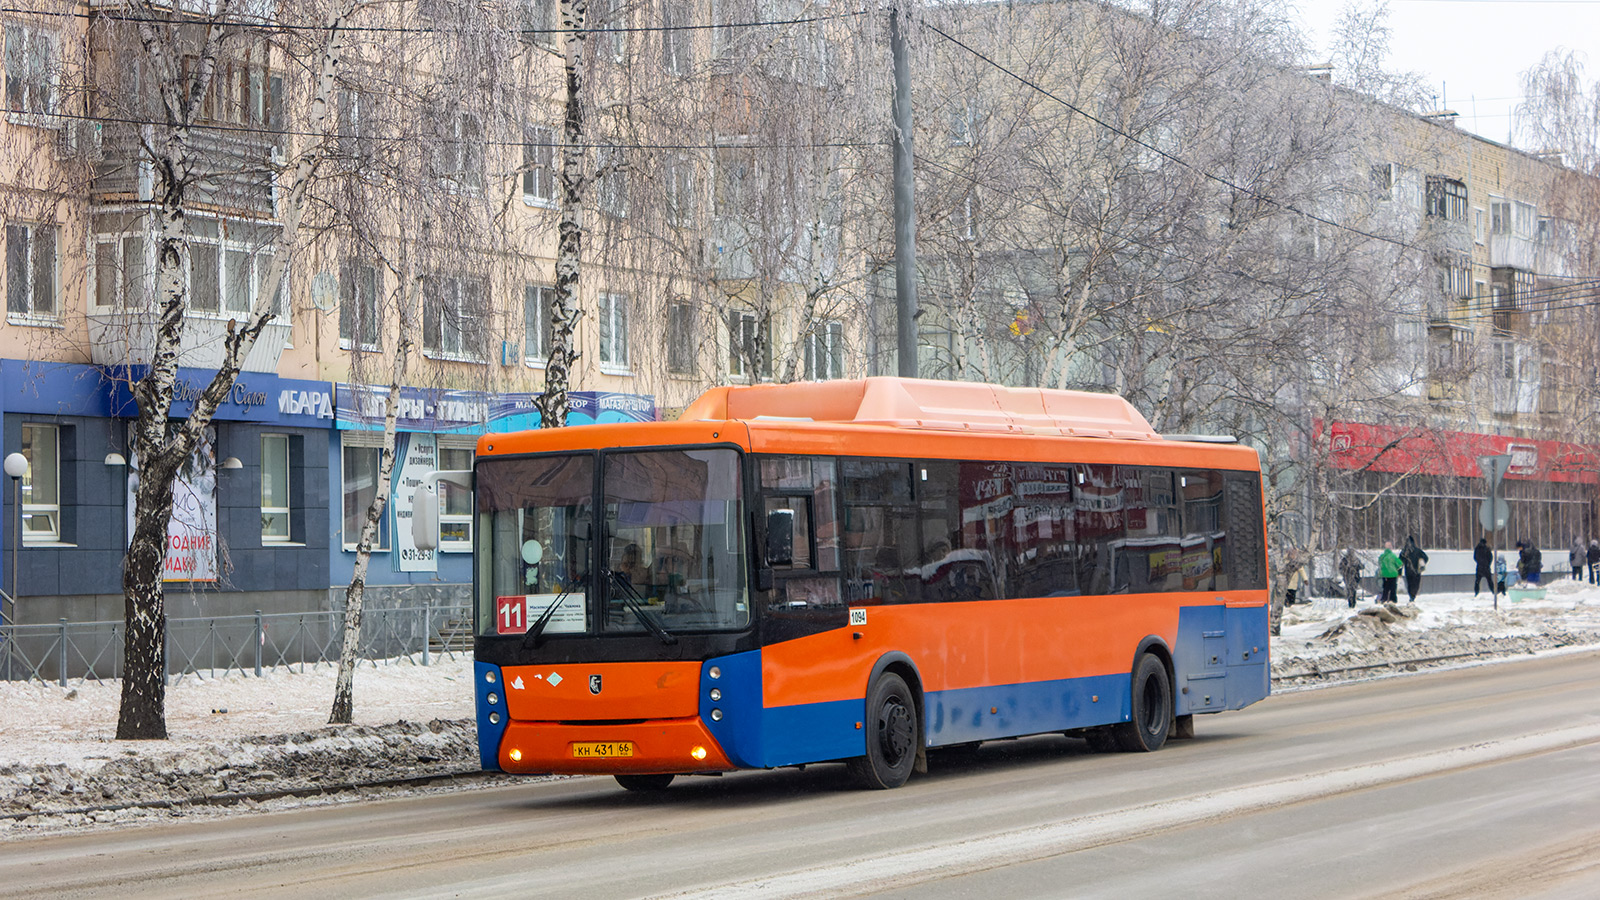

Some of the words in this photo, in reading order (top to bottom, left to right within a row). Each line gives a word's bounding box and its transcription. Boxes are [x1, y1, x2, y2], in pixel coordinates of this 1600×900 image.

[234, 383, 268, 414] Салон
[568, 400, 588, 409] ТОР
[599, 399, 631, 410] МАГАЗИН
[631, 400, 651, 411] ШТОР
[500, 603, 521, 628] 11
[851, 611, 865, 624] 1094
[578, 747, 590, 755] КН
[594, 744, 612, 755] 431
[618, 743, 629, 752] 66
